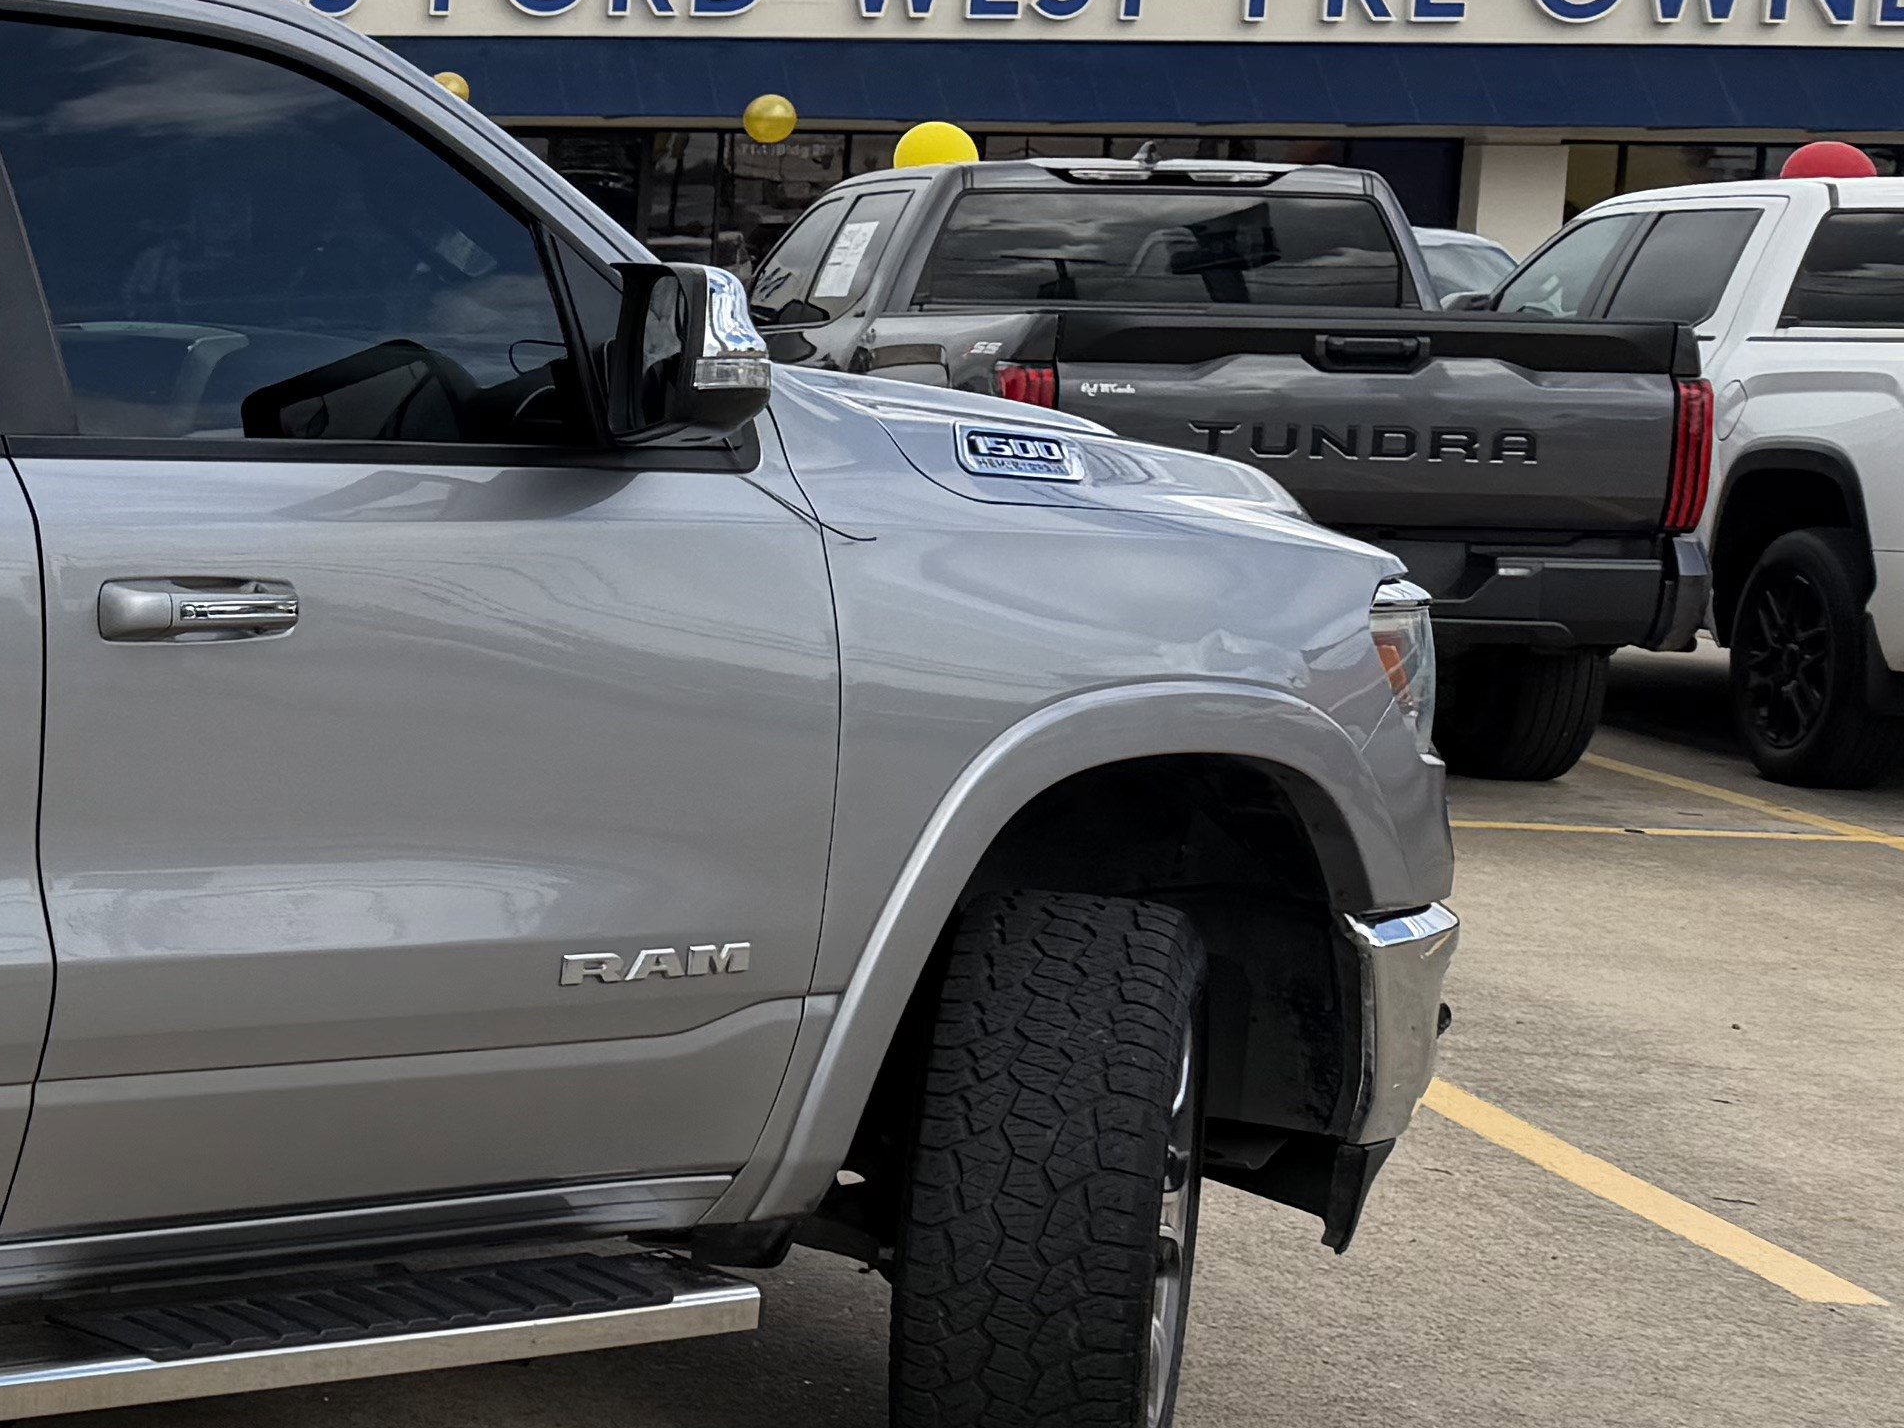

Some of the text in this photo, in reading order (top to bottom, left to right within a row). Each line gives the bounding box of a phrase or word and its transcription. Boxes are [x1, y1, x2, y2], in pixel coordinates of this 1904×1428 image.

[970, 435, 1063, 460] 1500
[1186, 419, 1539, 466] TUNDRA
[558, 941, 753, 987] RAM
